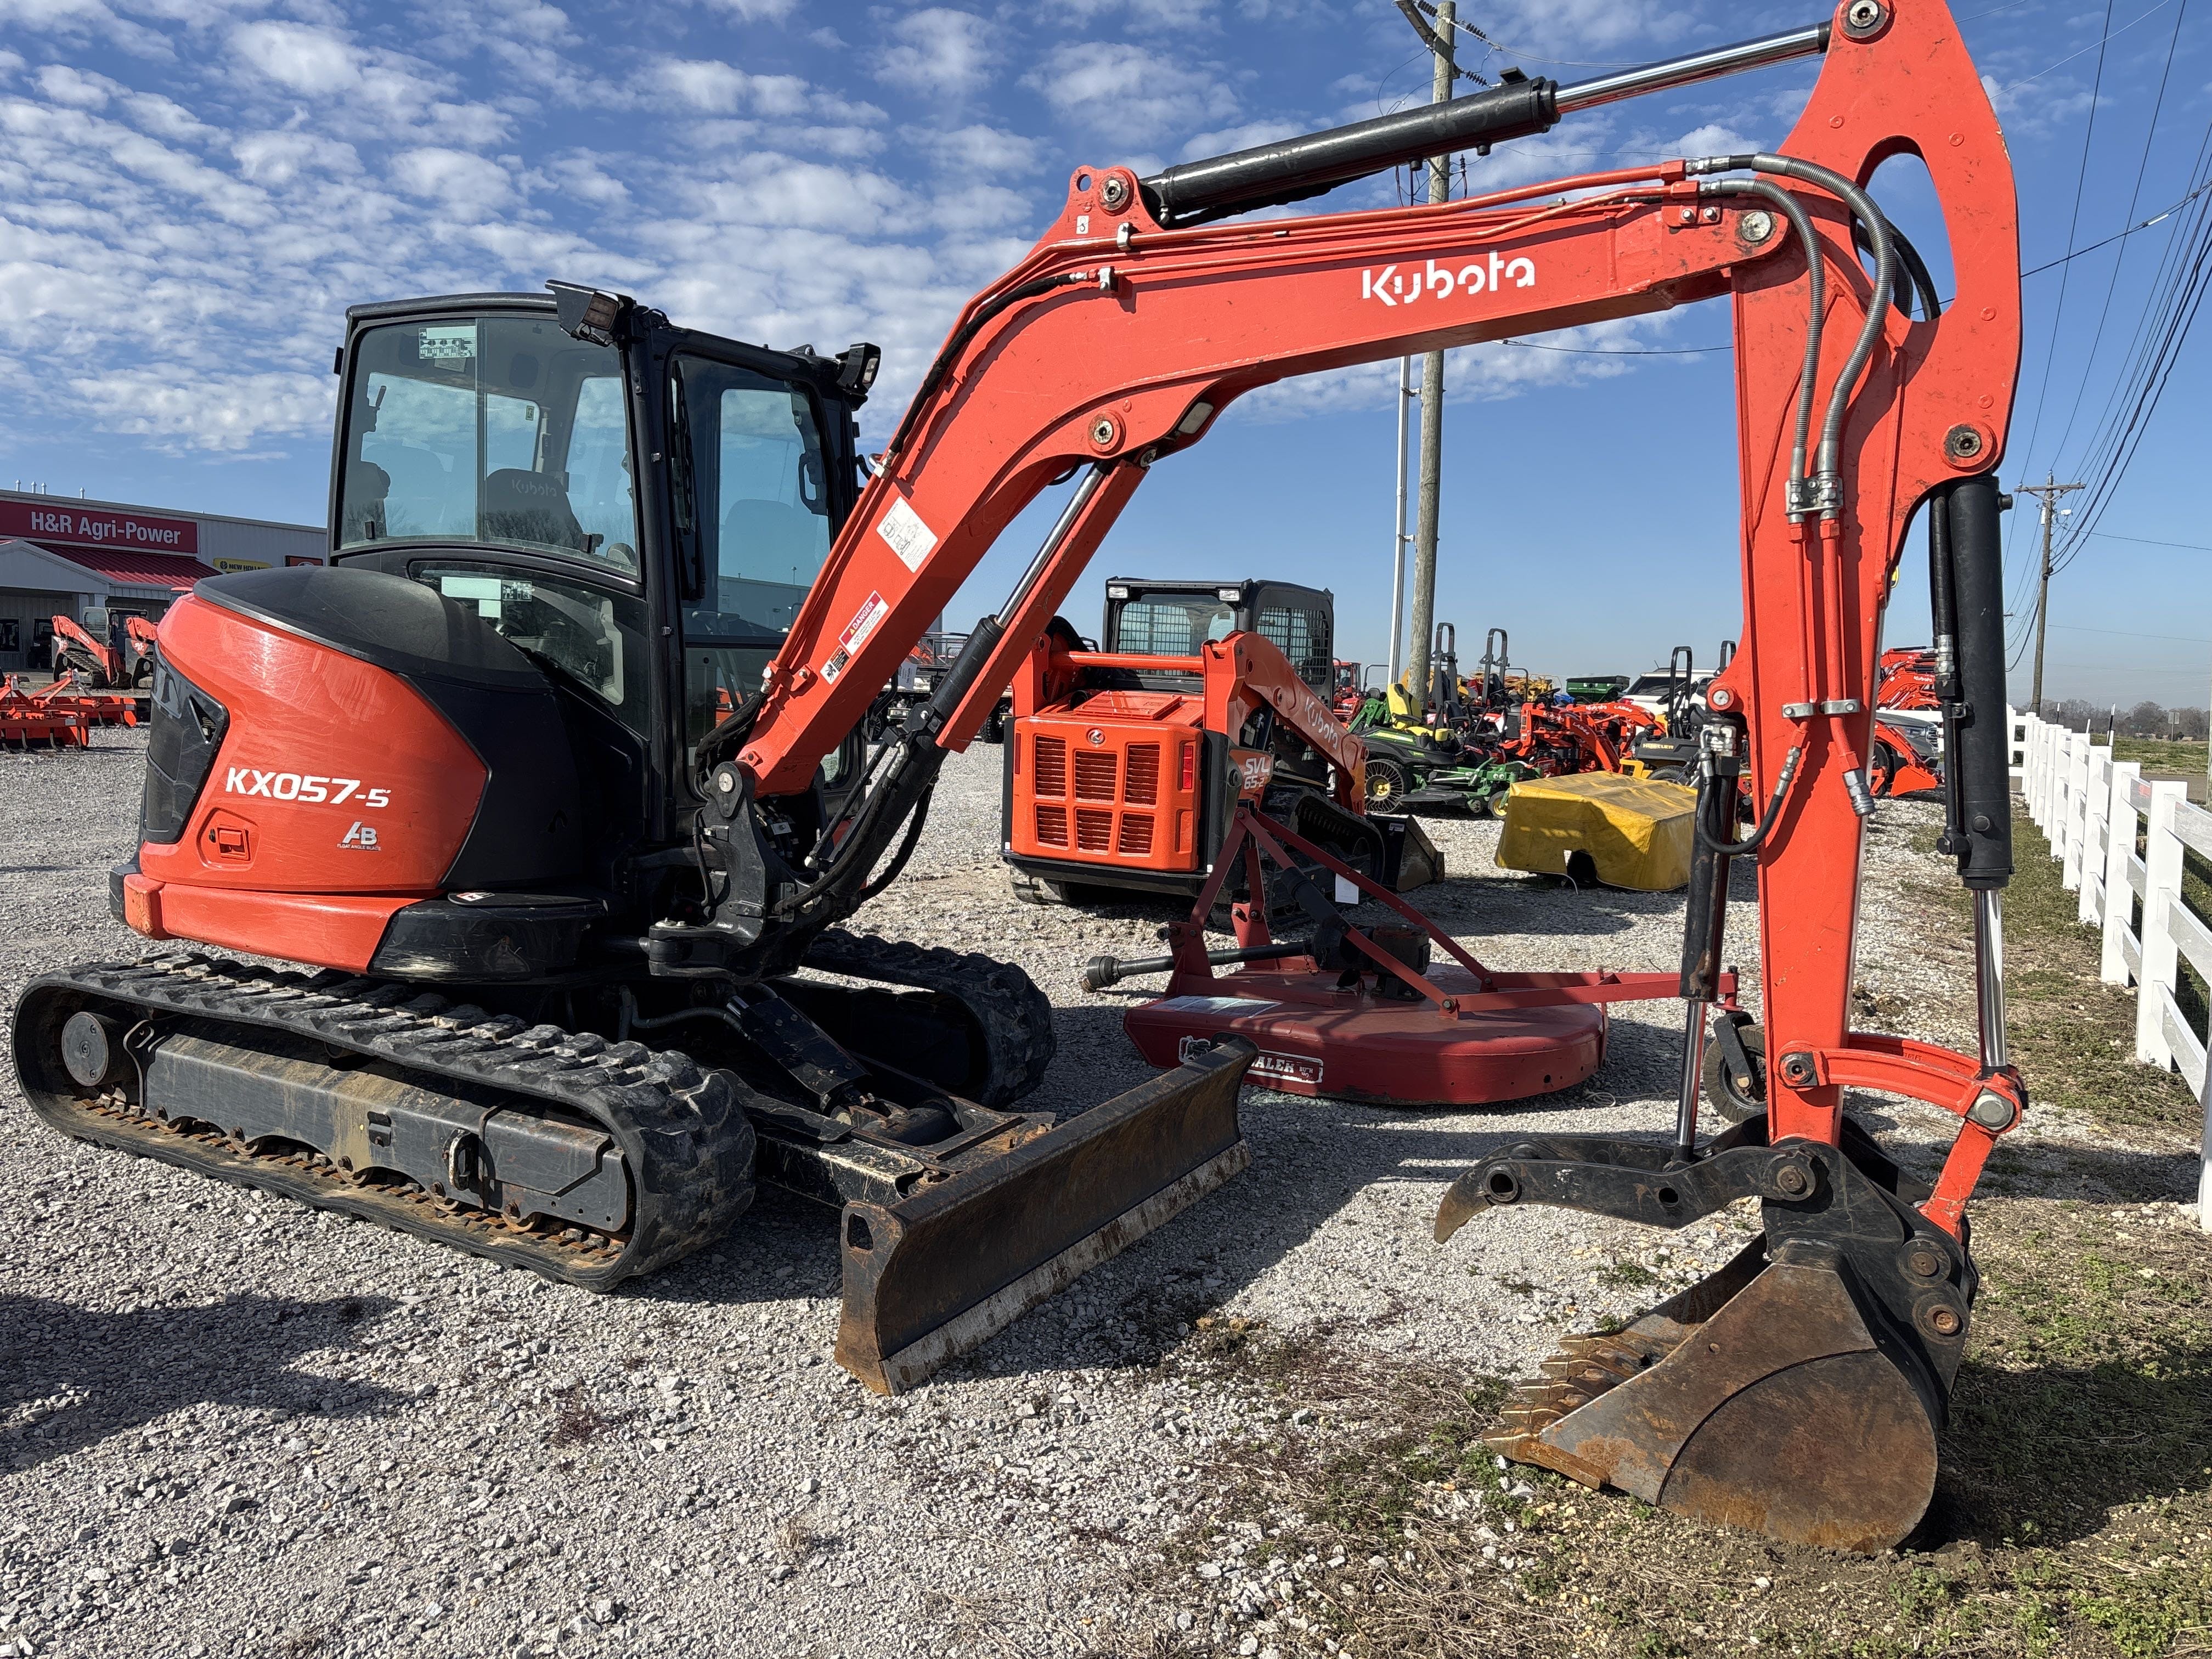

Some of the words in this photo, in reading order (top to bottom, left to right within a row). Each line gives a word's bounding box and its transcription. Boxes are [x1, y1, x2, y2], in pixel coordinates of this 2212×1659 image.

[1362, 250, 1535, 306] Kubota
[512, 478, 557, 497] Kubota
[31, 511, 72, 534] H&R
[78, 517, 181, 544] Agri-Power
[852, 601, 875, 630] DANGER
[1305, 696, 1338, 749] Kubota
[1244, 757, 1270, 776] SVL
[225, 767, 391, 808] KX057-5
[1244, 775, 1265, 790] 65-2
